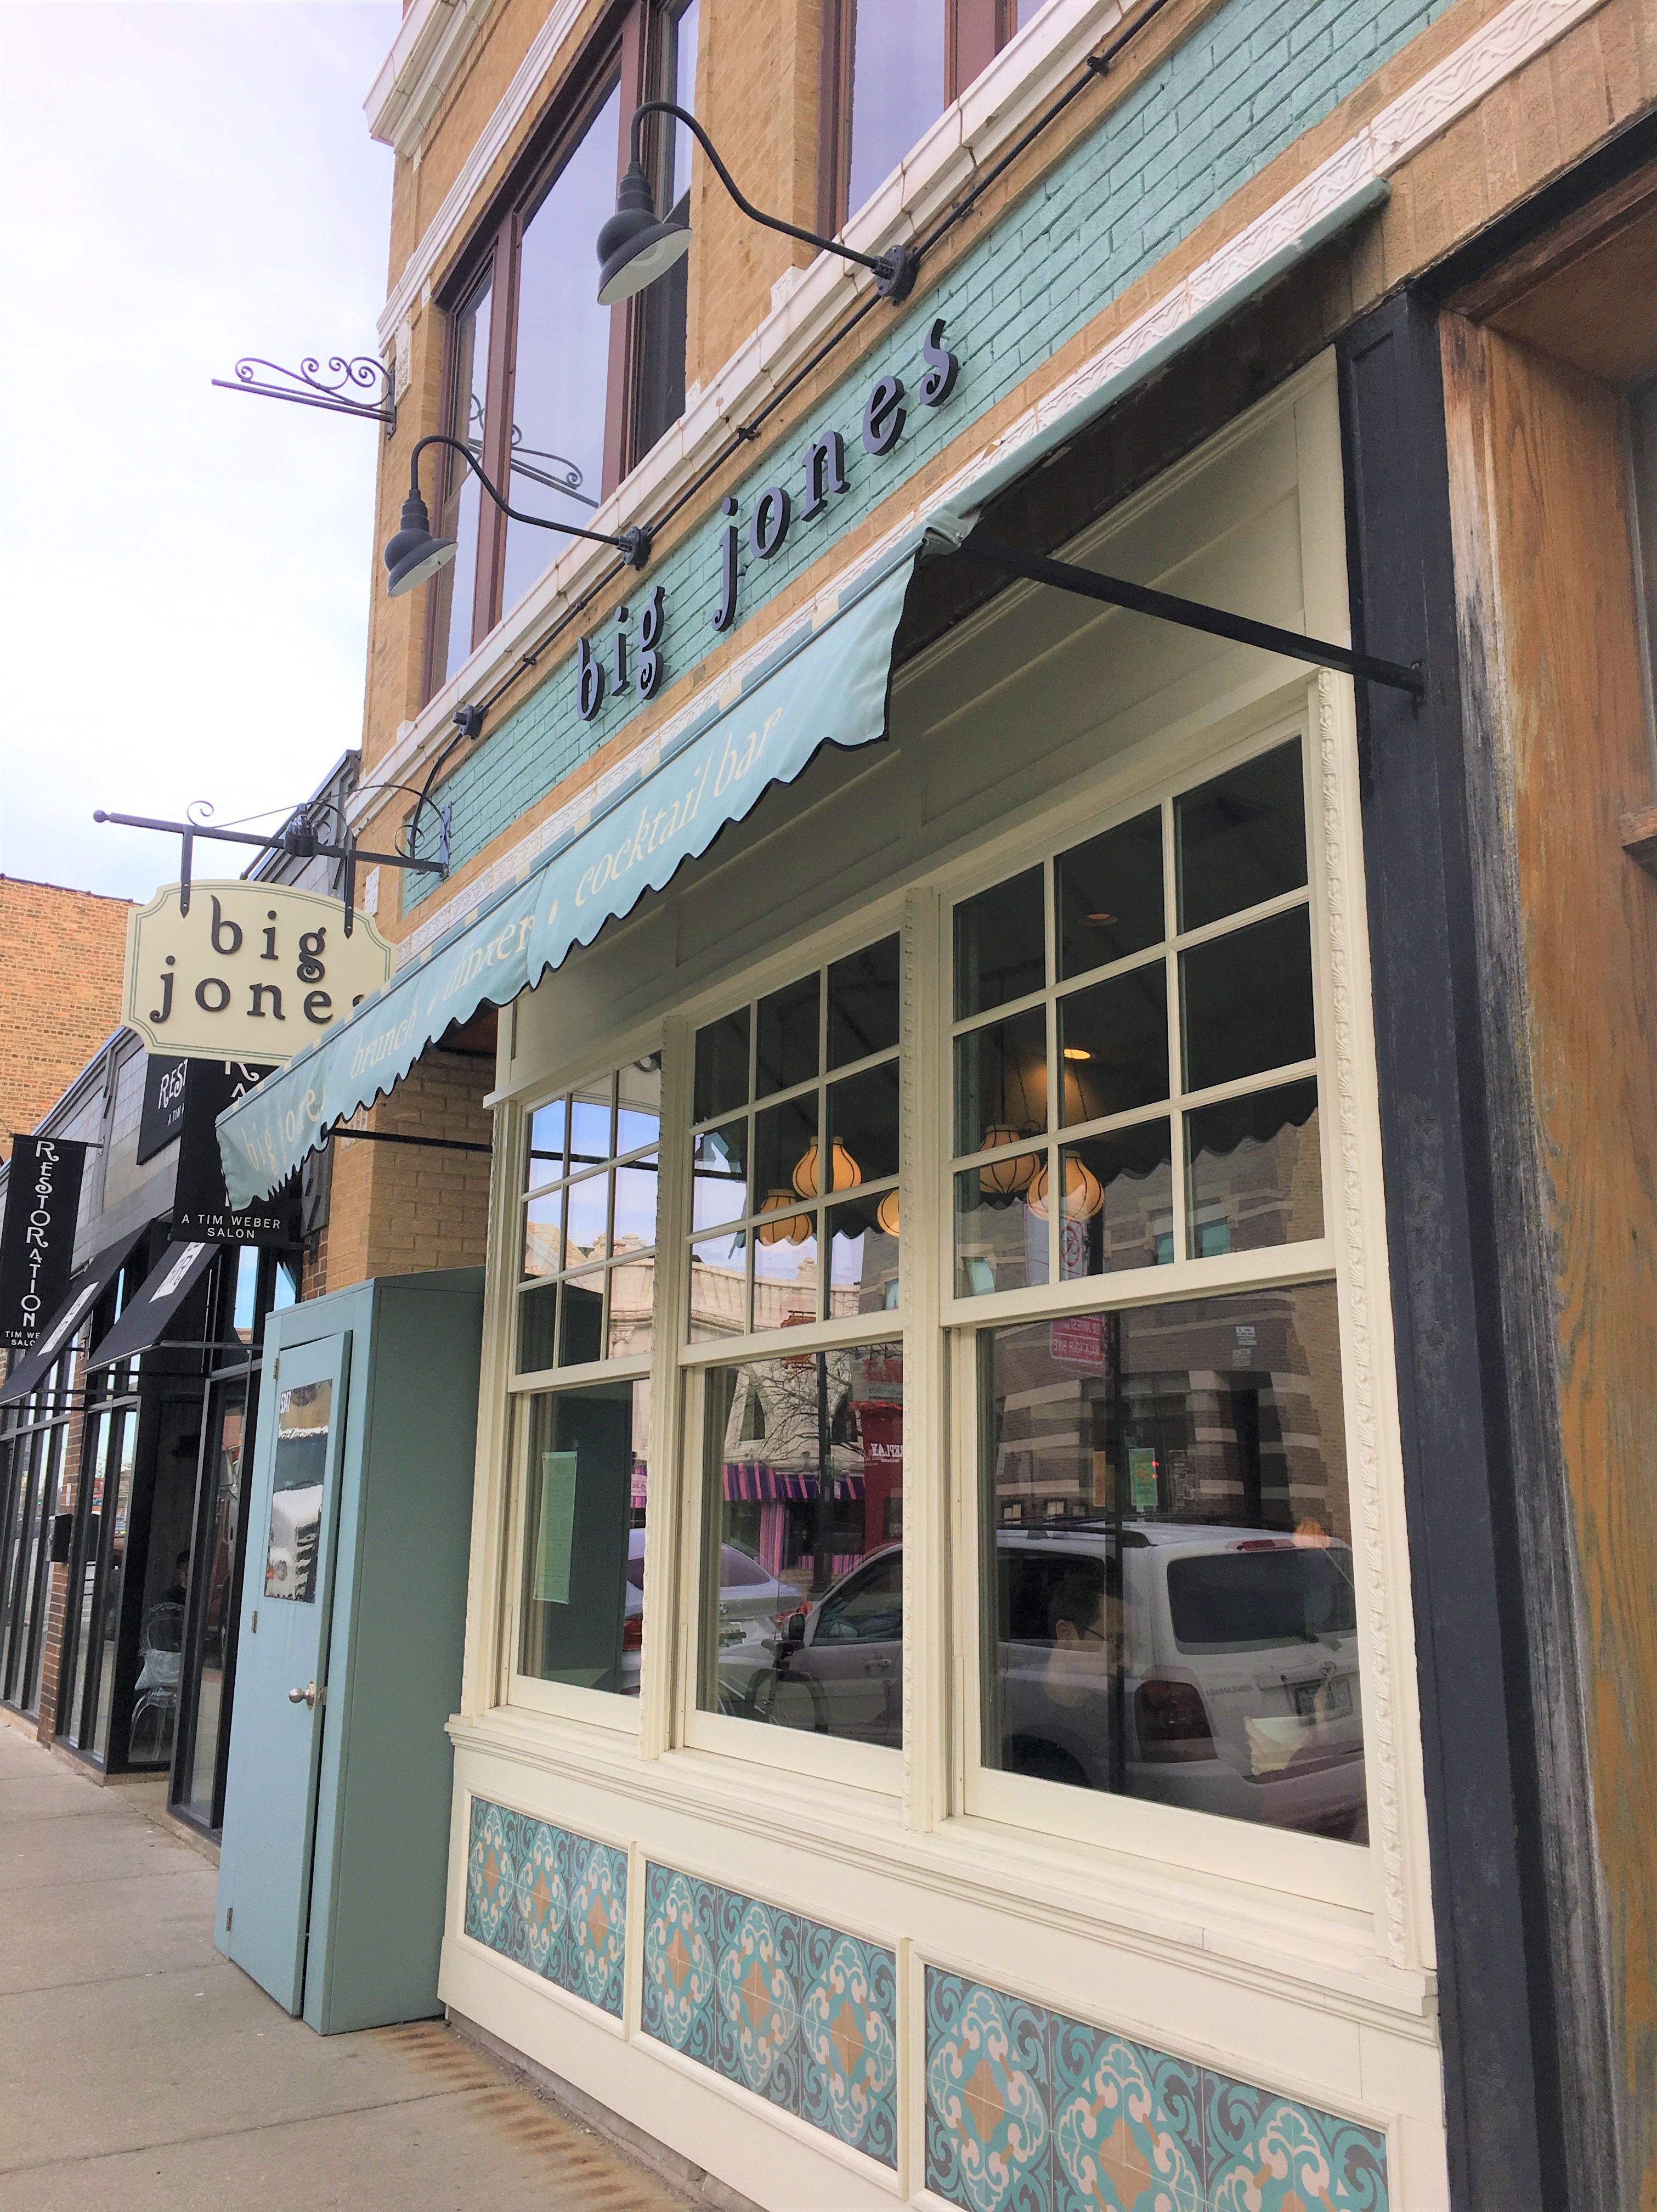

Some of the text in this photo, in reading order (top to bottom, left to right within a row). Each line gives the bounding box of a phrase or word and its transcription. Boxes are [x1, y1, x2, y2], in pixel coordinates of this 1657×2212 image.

[577, 318, 959, 721] big jones
[210, 895, 327, 983] big
[241, 1122, 278, 1176] big
[350, 997, 417, 1079] brunch
[575, 752, 713, 907] cocktail
[714, 707, 783, 798] bar
[21, 1140, 59, 1327] RESTORATION
[182, 1214, 281, 1229] A TIM WEBER
[207, 1228, 255, 1239] SALON
